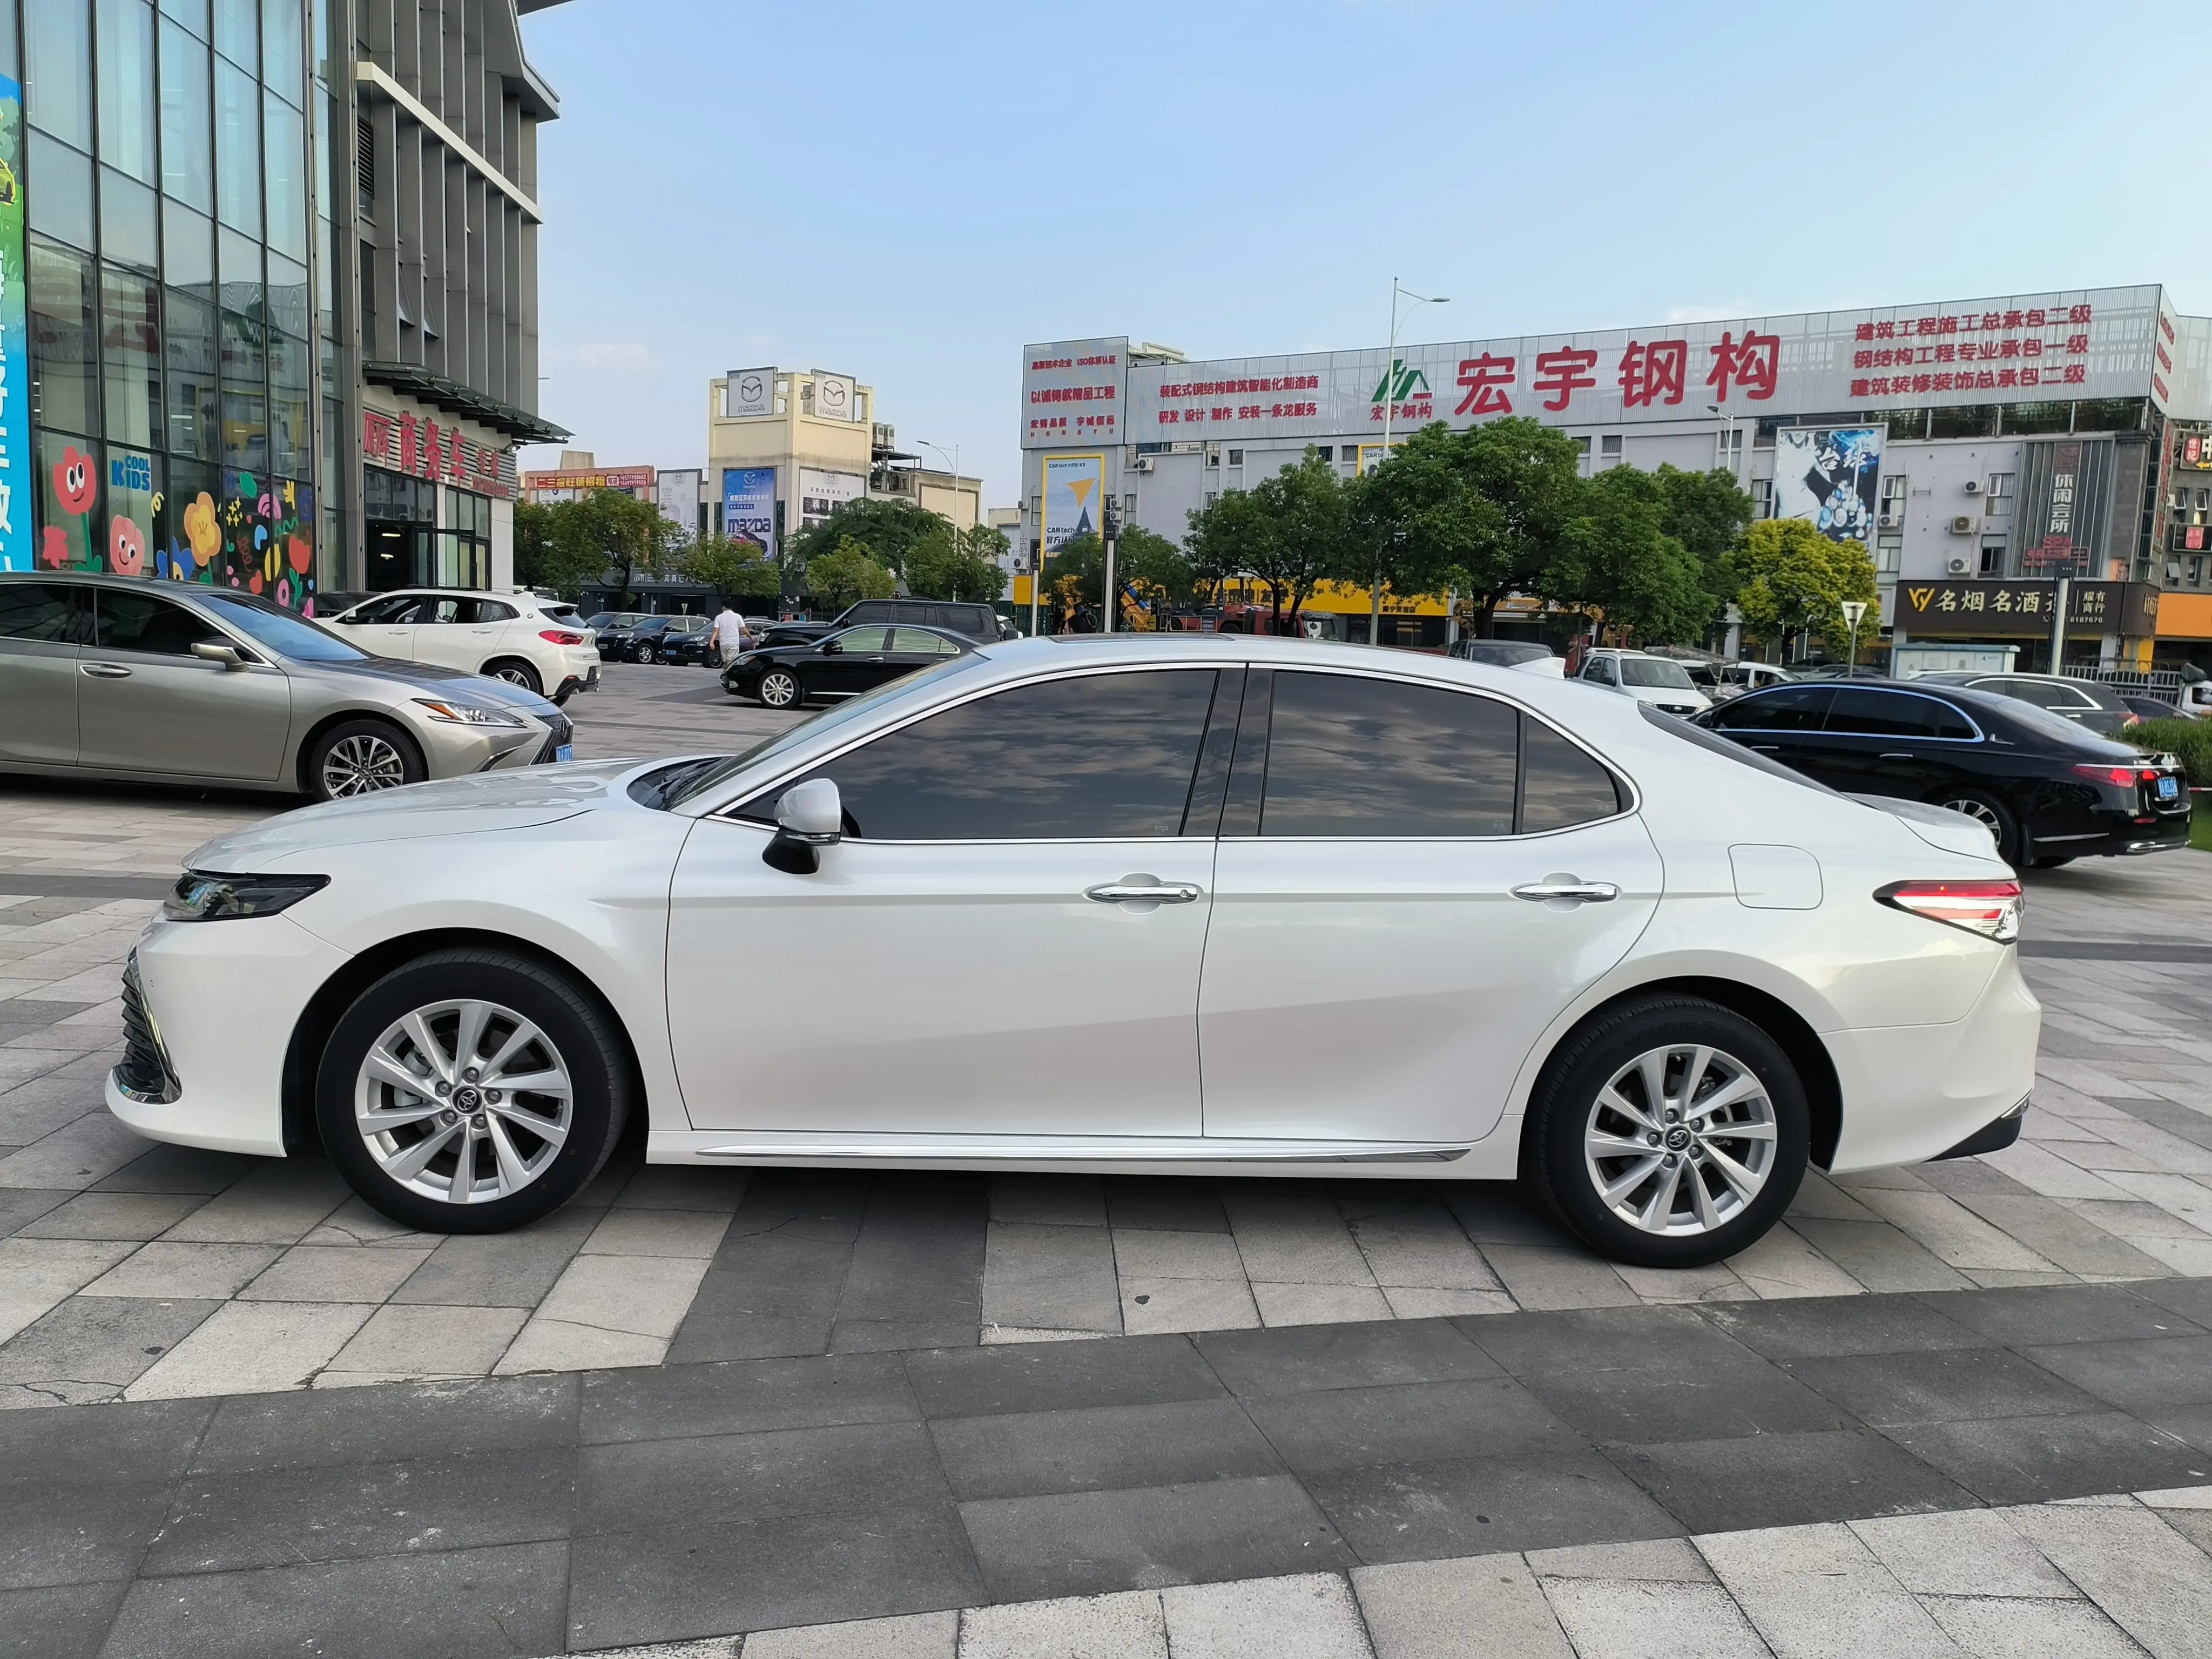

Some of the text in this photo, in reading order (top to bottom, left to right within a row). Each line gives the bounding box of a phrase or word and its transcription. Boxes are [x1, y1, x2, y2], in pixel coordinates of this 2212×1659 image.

[1856, 305, 2092, 341] 建筑工程施工总承包二级
[1853, 334, 2088, 368] 钢结构工程专业承包一级
[1032, 359, 1073, 370] 高新技术企业
[1454, 330, 1781, 415] 宏宇钢构
[1160, 375, 1319, 397] 装配式钢结构建筑智能化制造商
[1850, 365, 2085, 397] 建筑装修装饰总承包二级
[1031, 386, 1116, 403] 以诚铸就精品工程
[1159, 402, 1317, 423] 研发 设计 制作 安装一条龙服务
[1370, 402, 1432, 421] 宏宇钢构
[125, 455, 151, 472] COOL
[112, 460, 151, 491] KIDS
[538, 476, 605, 488] 二三层旺铺招租
[2050, 474, 2074, 534] 休闲会所
[728, 518, 771, 533] mazda
[2042, 536, 2073, 549] SPA
